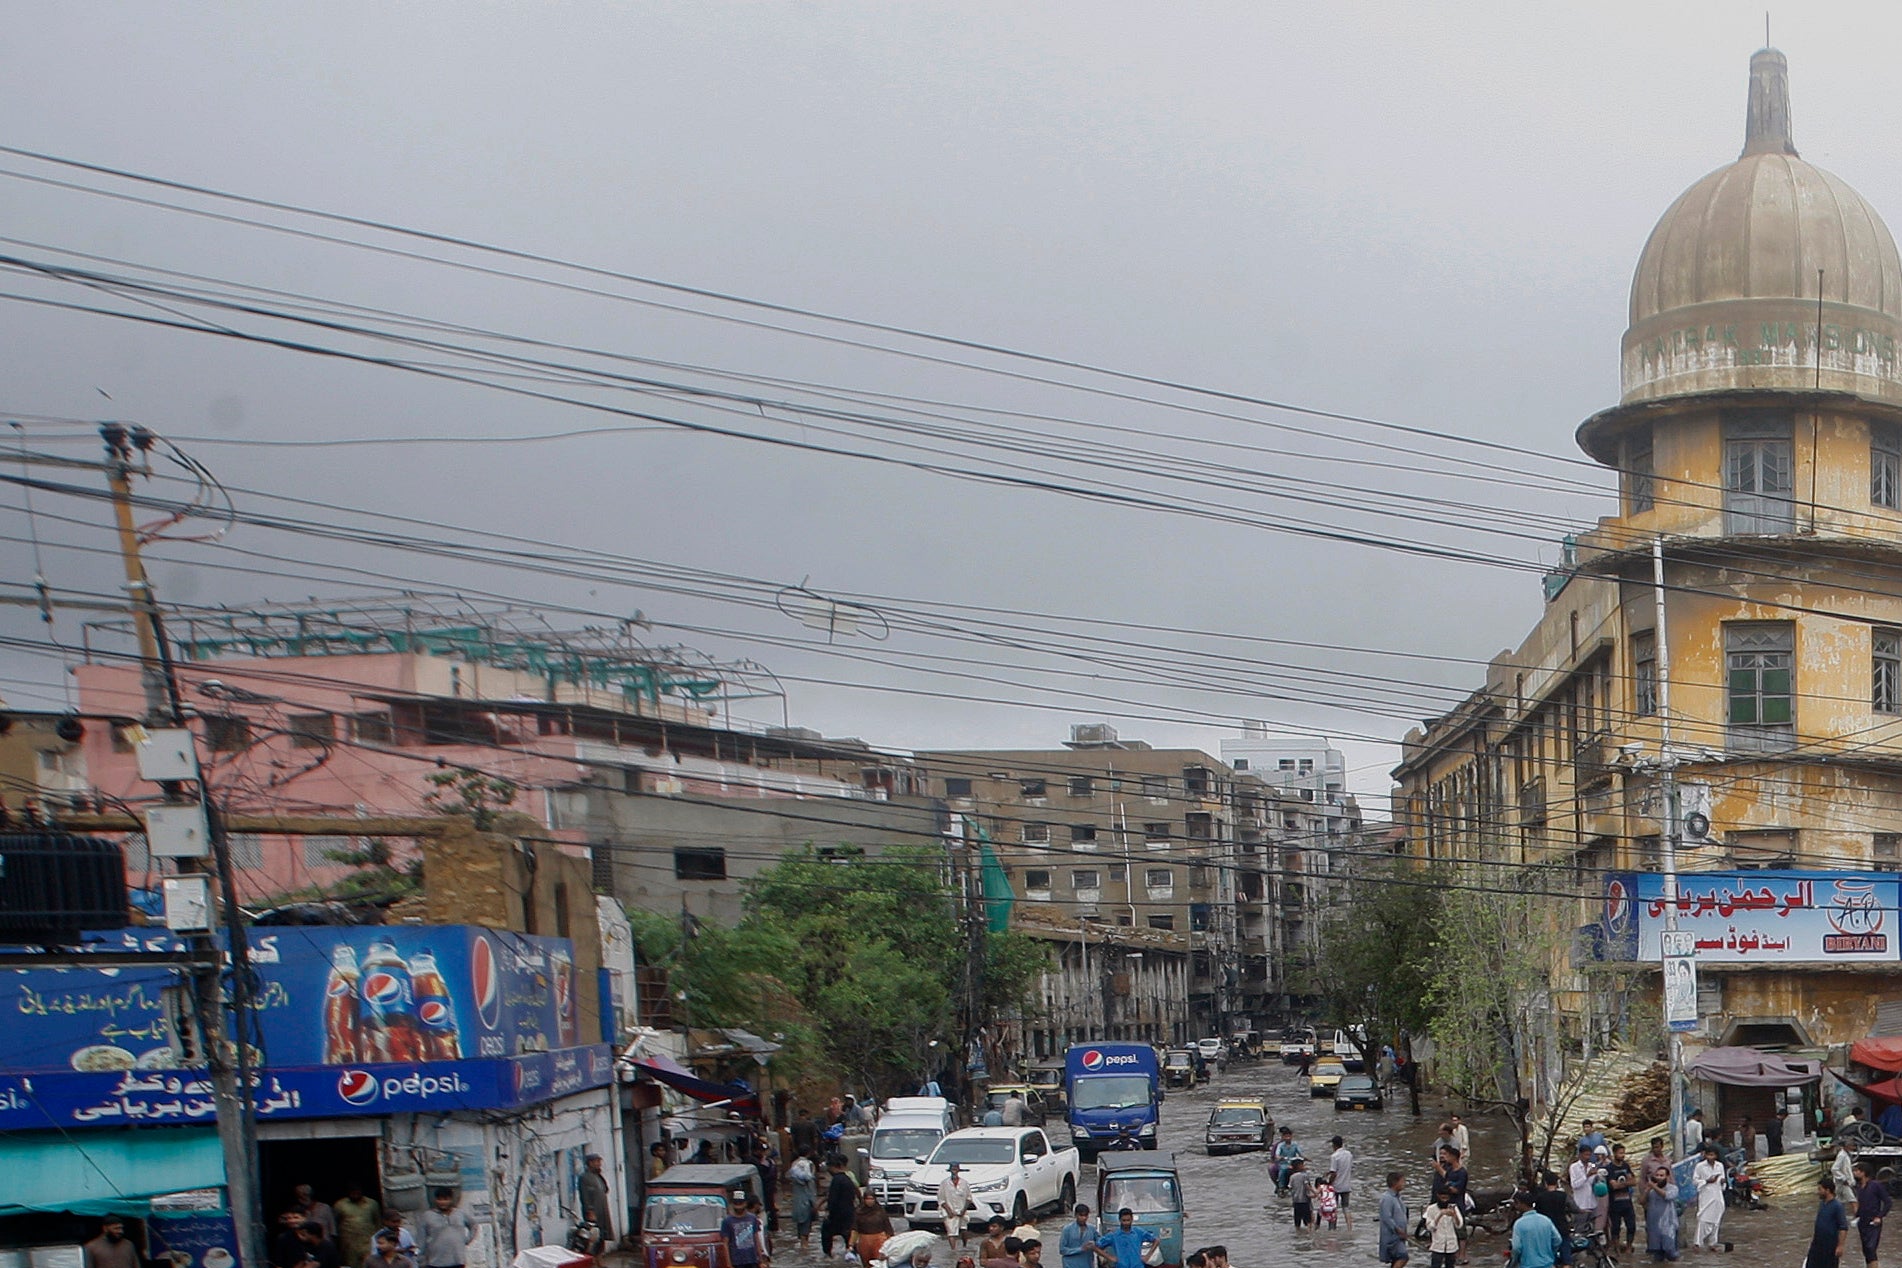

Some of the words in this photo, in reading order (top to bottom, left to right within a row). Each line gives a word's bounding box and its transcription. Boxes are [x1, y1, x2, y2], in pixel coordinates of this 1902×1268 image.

[1825, 936, 1886, 952] BIRYANI
[383, 1071, 462, 1099] pepsi
[72, 1097, 184, 1123] بریانی
